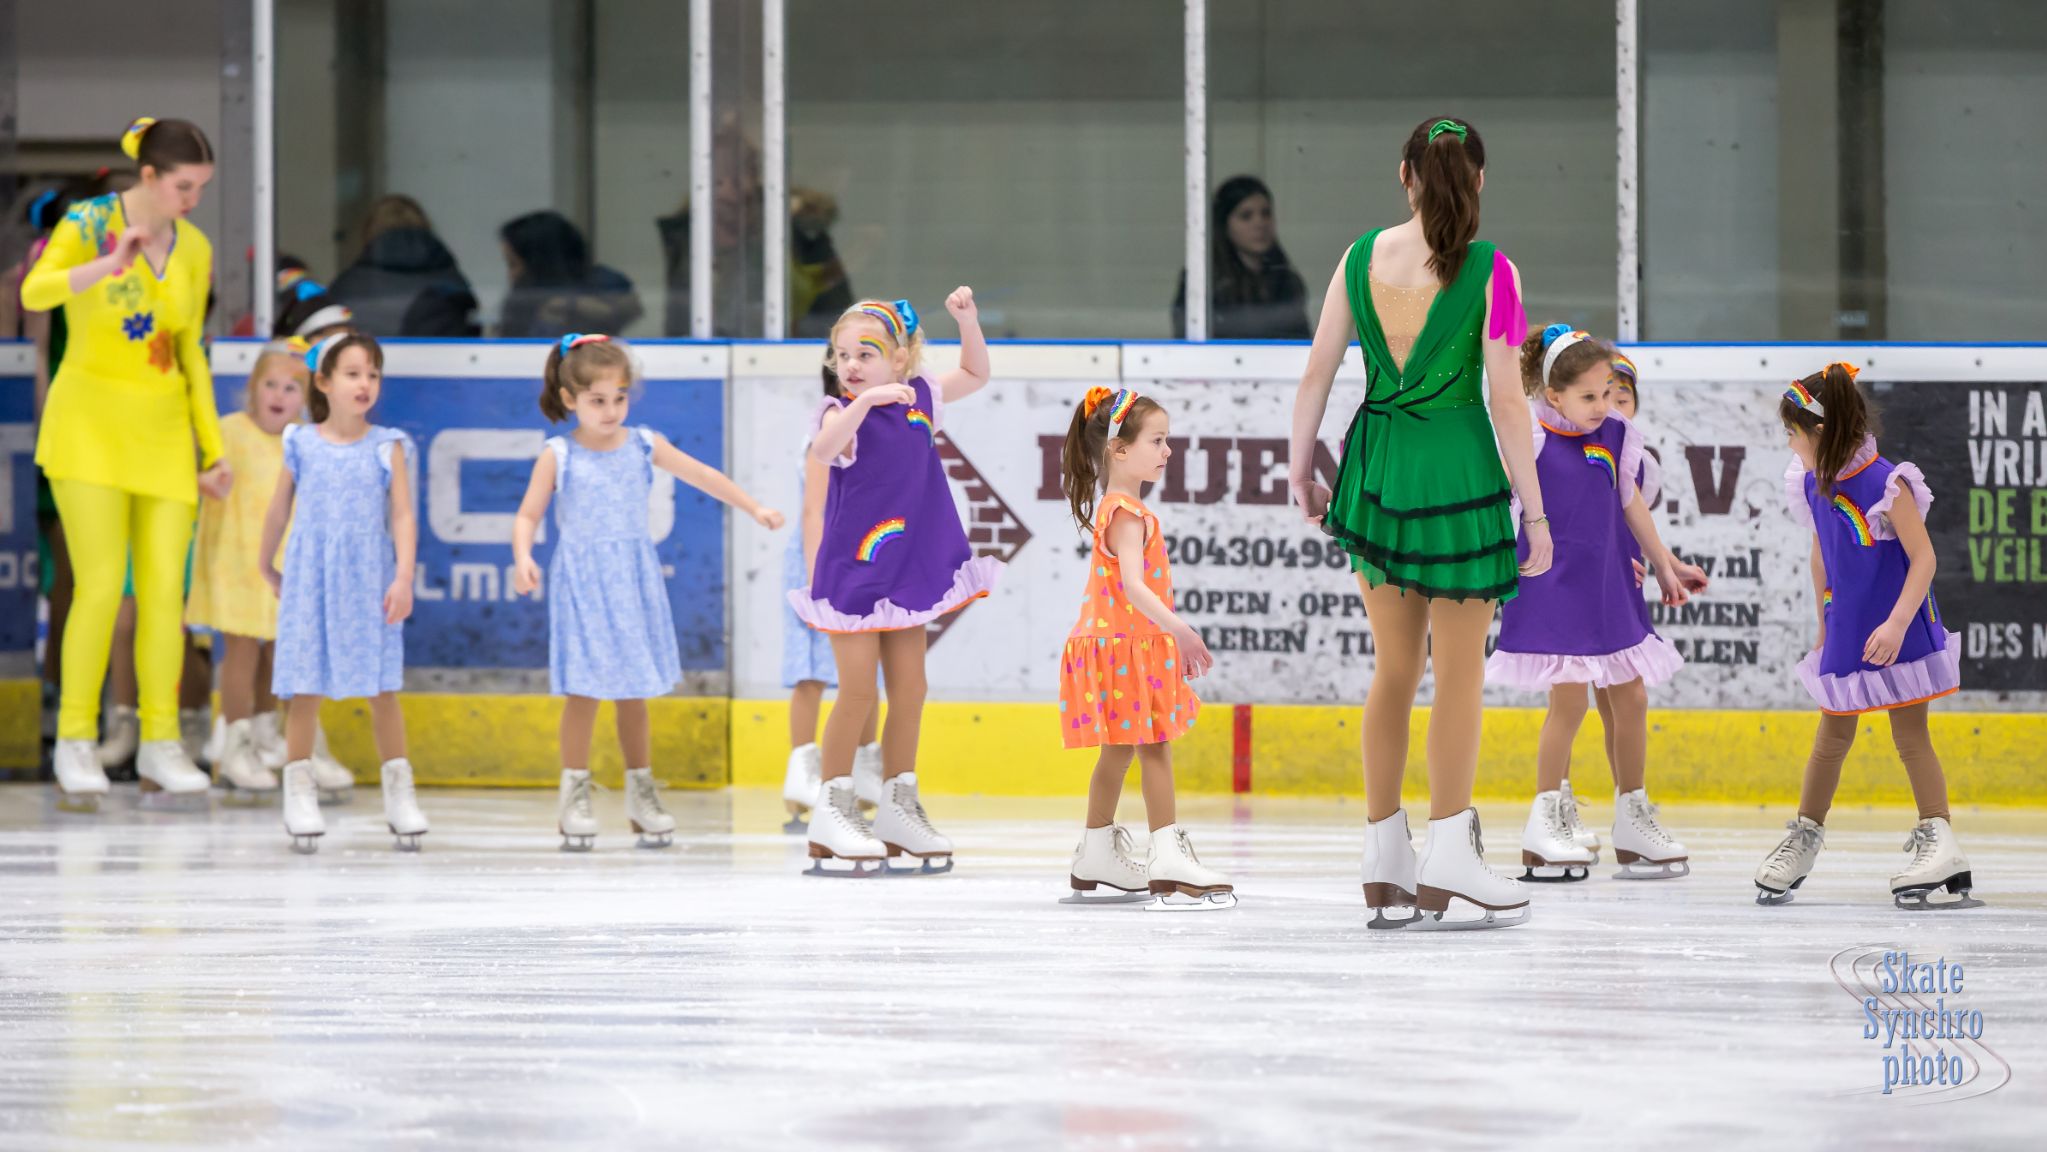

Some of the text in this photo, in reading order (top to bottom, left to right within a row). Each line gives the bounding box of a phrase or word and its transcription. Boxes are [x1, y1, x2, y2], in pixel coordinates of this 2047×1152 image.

[1967, 438, 2047, 486] VRIJ
[1968, 488, 2017, 535] DE
[1967, 537, 2047, 582] VEIL
[1298, 592, 1368, 618] OPP
[1190, 625, 1307, 653] LEREN
[1967, 622, 2024, 660] DES
